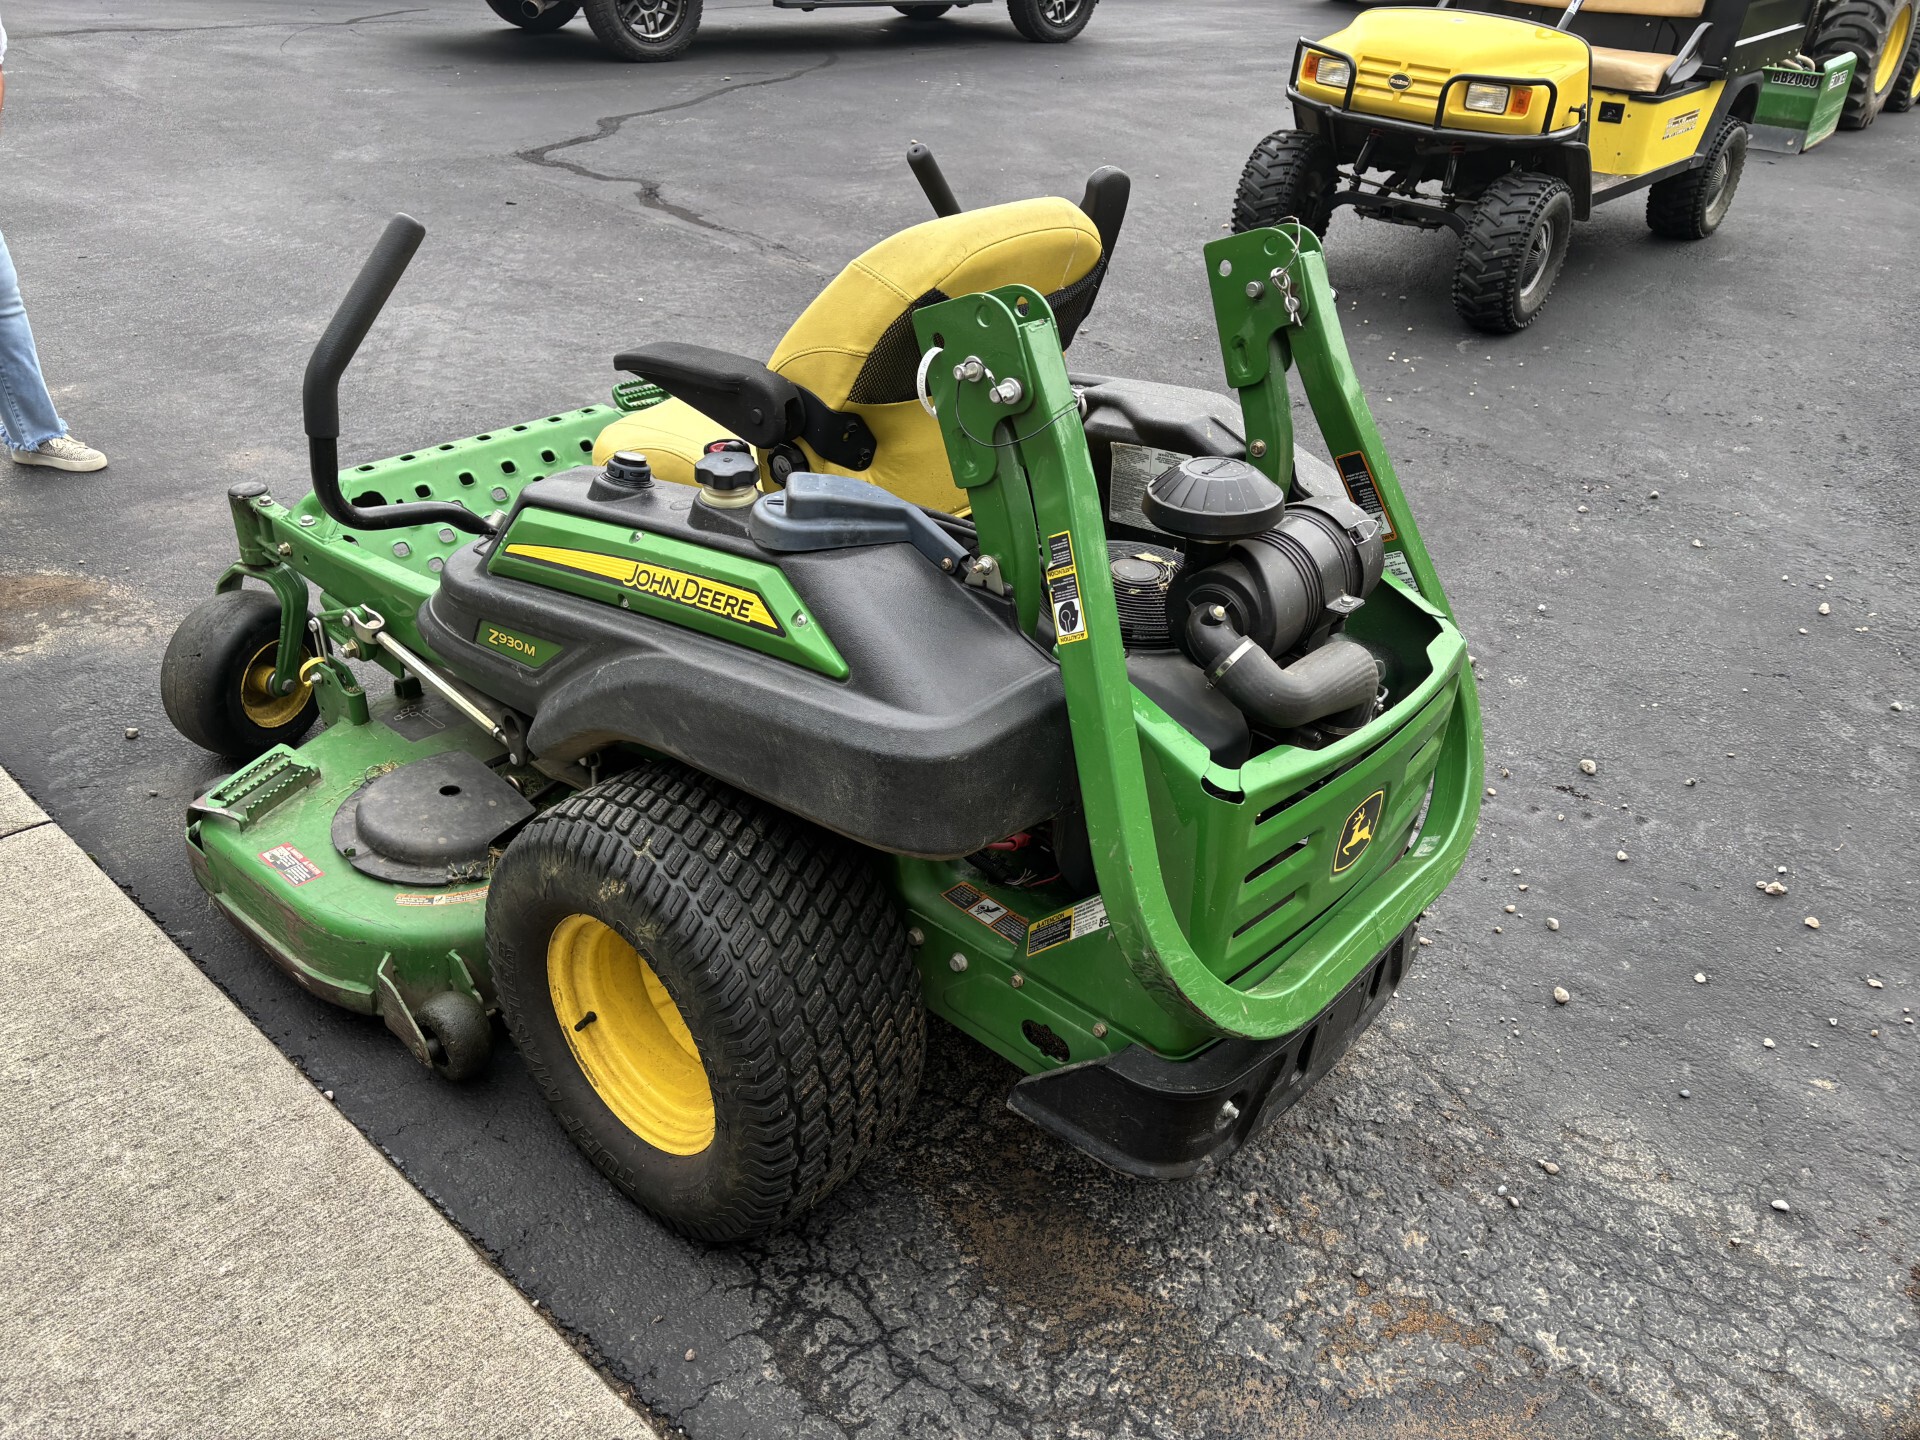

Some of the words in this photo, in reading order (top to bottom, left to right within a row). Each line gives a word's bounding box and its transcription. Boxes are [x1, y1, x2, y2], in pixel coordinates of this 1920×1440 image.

[1772, 72, 1819, 88] BB2060
[623, 564, 679, 598] JOHN
[682, 579, 753, 619] DEERE
[488, 628, 536, 657] Z930M
[498, 941, 562, 1102] MASTER
[559, 1112, 636, 1192] TURF
